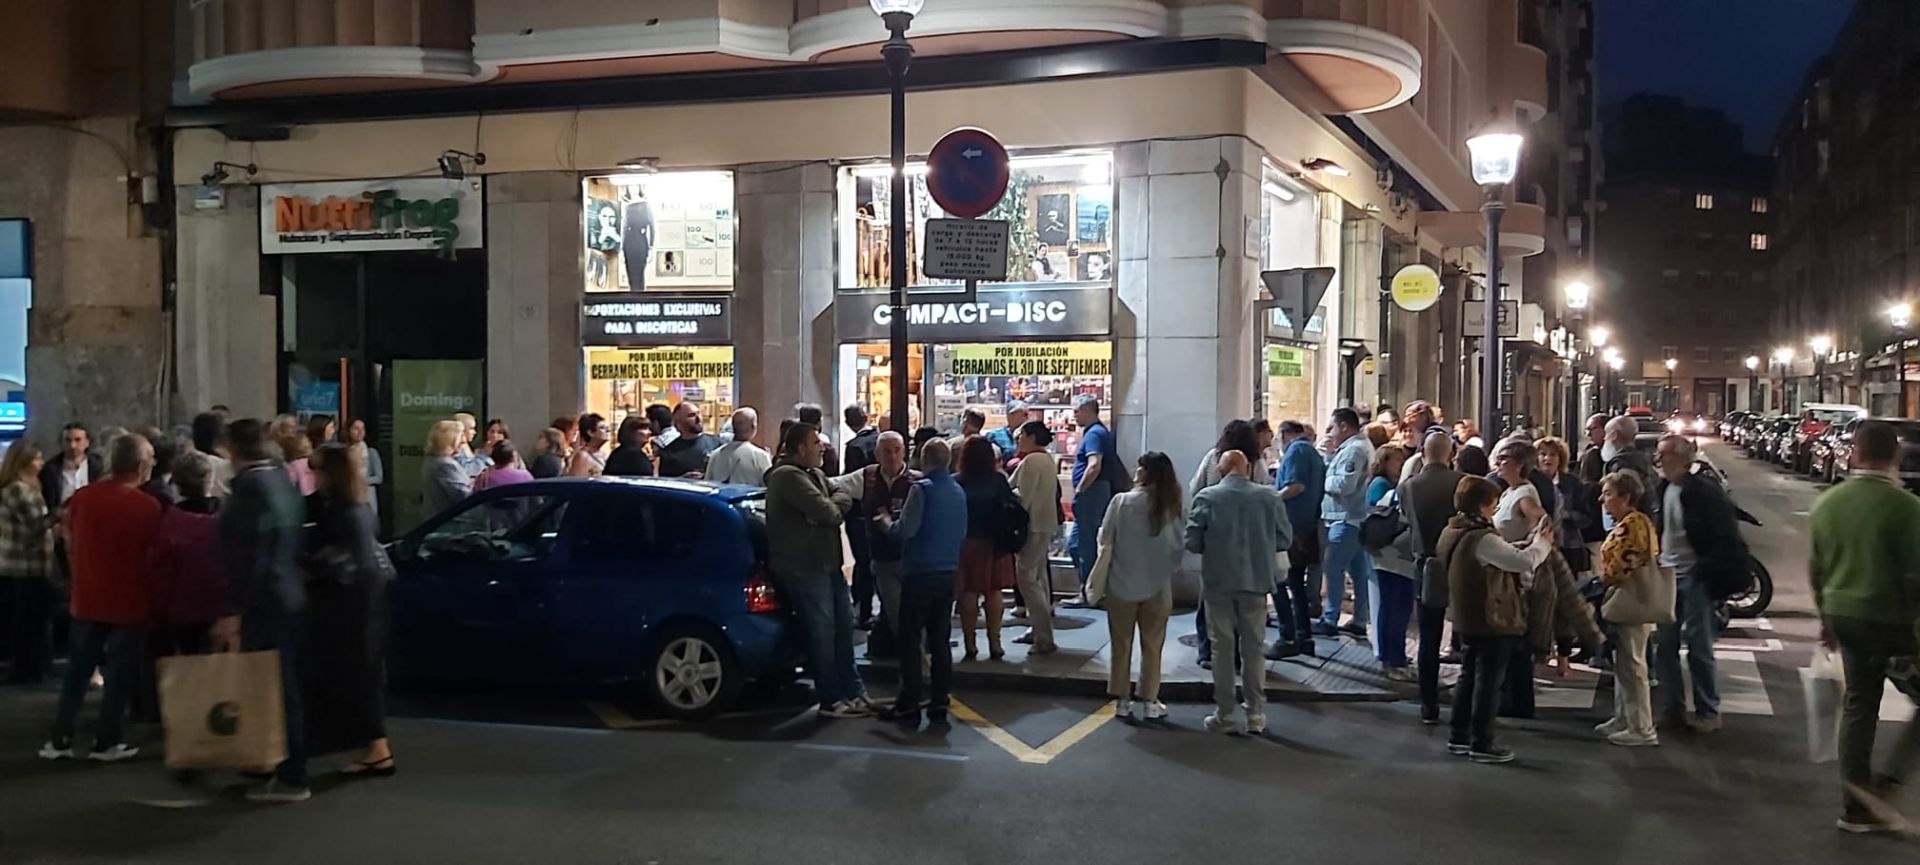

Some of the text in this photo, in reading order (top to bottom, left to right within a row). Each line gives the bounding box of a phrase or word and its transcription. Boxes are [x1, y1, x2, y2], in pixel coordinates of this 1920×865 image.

[275, 188, 461, 258] NutriFrog
[320, 233, 326, 244] y
[966, 231, 1001, 239] descarga
[663, 302, 722, 316] EXCLUSIVAS
[873, 300, 1067, 325] CMPACT-DISC
[604, 320, 698, 334] PARA DISCOTECAS
[628, 351, 694, 362] POR JUBILACIÓN
[995, 345, 1069, 357] POR JUBILACIÓN
[591, 362, 734, 379] CERRAMOS EL 30 DE SEPTIEMBRE
[952, 358, 1006, 376] CERRAMOS
[1008, 358, 1018, 375] EL
[1020, 358, 1034, 375] 30
[1036, 358, 1049, 375] DE
[400, 392, 474, 409] Domingo
